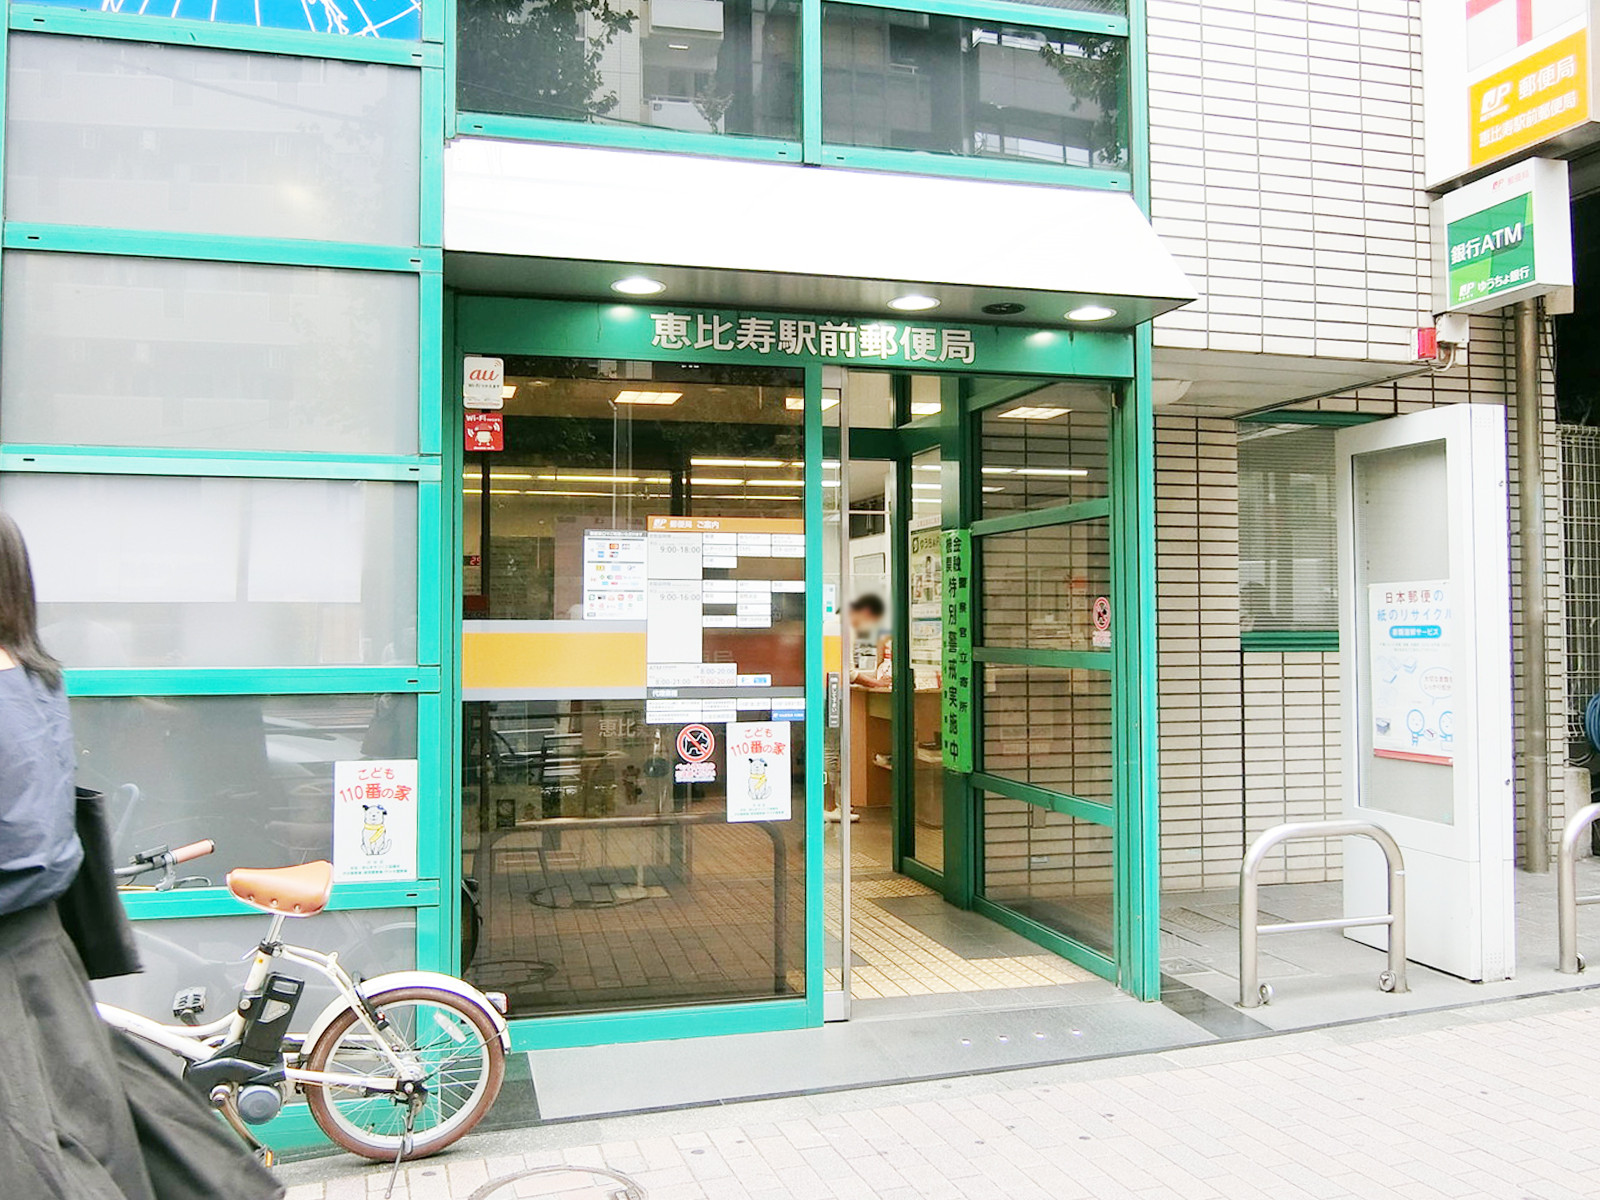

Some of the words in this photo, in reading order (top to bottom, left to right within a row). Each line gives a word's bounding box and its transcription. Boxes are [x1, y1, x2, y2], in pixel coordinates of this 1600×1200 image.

[1519, 55, 1576, 100] 郵便局
[1479, 90, 1577, 148] 恵比寿駅前郵便局
[1450, 222, 1522, 264] 銀行ATM
[1478, 266, 1530, 292] ゆうちょ銀行
[650, 312, 976, 364] 恵比寿駅前郵便局
[469, 368, 499, 381] au
[1386, 589, 1444, 604] 日本郵便の
[744, 728, 773, 739] こども
[730, 740, 786, 757] 110番の家
[358, 767, 395, 781] こども
[339, 783, 412, 803] 110番の家
